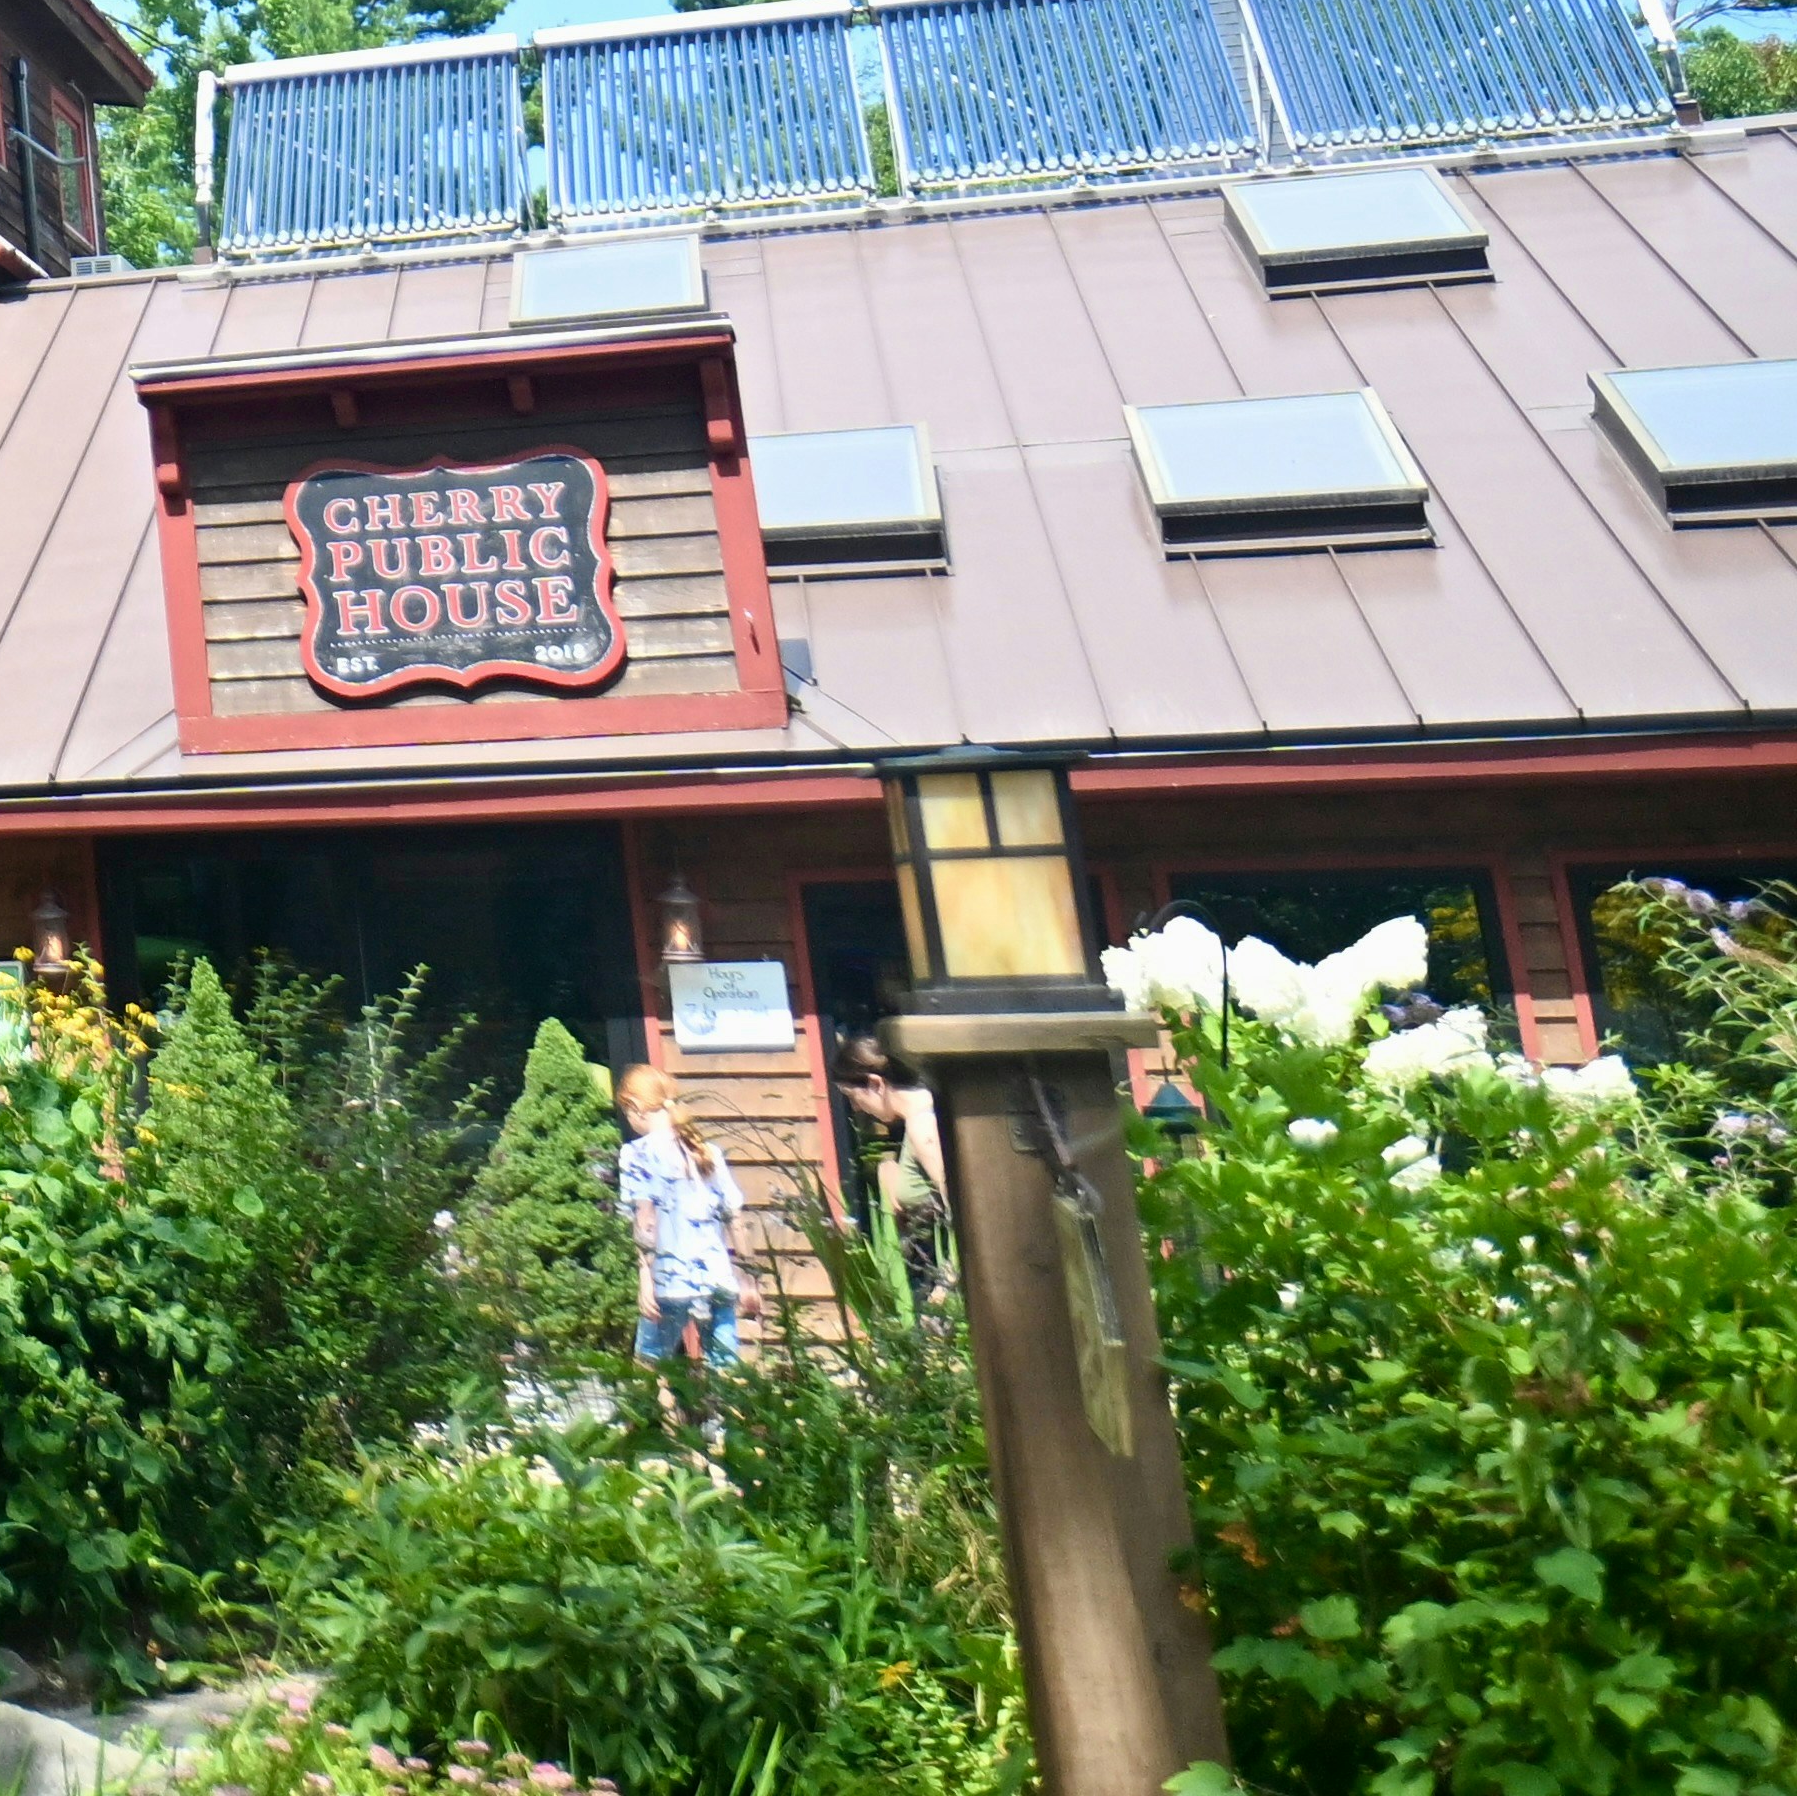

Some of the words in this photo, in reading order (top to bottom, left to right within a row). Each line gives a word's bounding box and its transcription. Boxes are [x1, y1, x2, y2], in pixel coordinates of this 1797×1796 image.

[323, 481, 566, 534] CHERRY
[325, 526, 571, 582] PUBLIC
[332, 575, 579, 636] HOUSE
[534, 643, 586, 661] 2018
